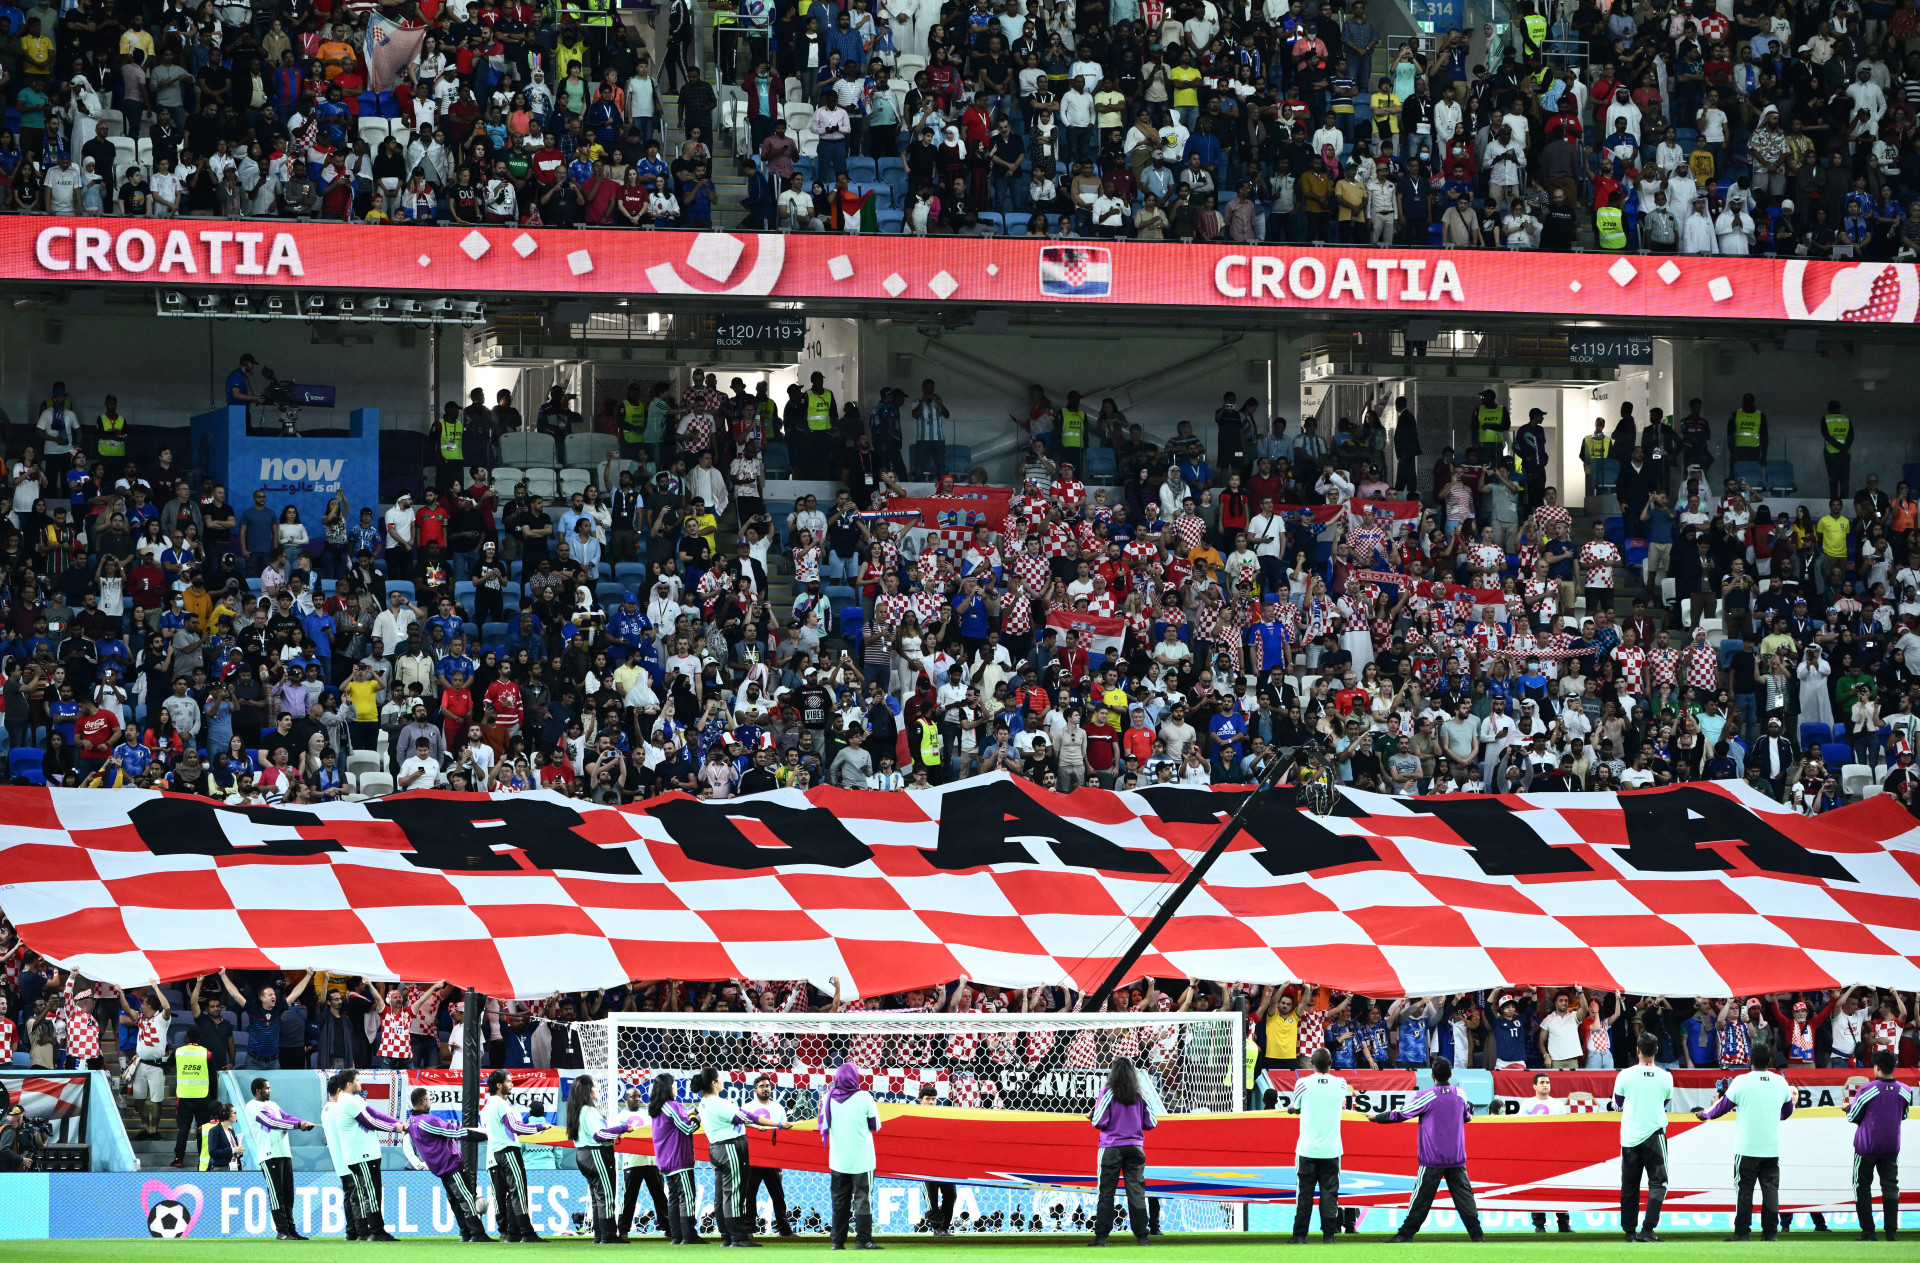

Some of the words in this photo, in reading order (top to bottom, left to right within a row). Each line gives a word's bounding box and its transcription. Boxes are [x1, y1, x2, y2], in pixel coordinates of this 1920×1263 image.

[36, 226, 305, 276] CROATIA
[1215, 254, 1465, 302] CROATIA
[260, 458, 344, 481] now
[314, 482, 324, 493] is
[324, 482, 341, 493] all
[1357, 571, 1405, 585] CROATIA
[1216, 728, 1238, 737] adidas
[128, 778, 1858, 883] CROATIA
[1414, 1030, 1420, 1038] 9
[1509, 1027, 1519, 1038] 17
